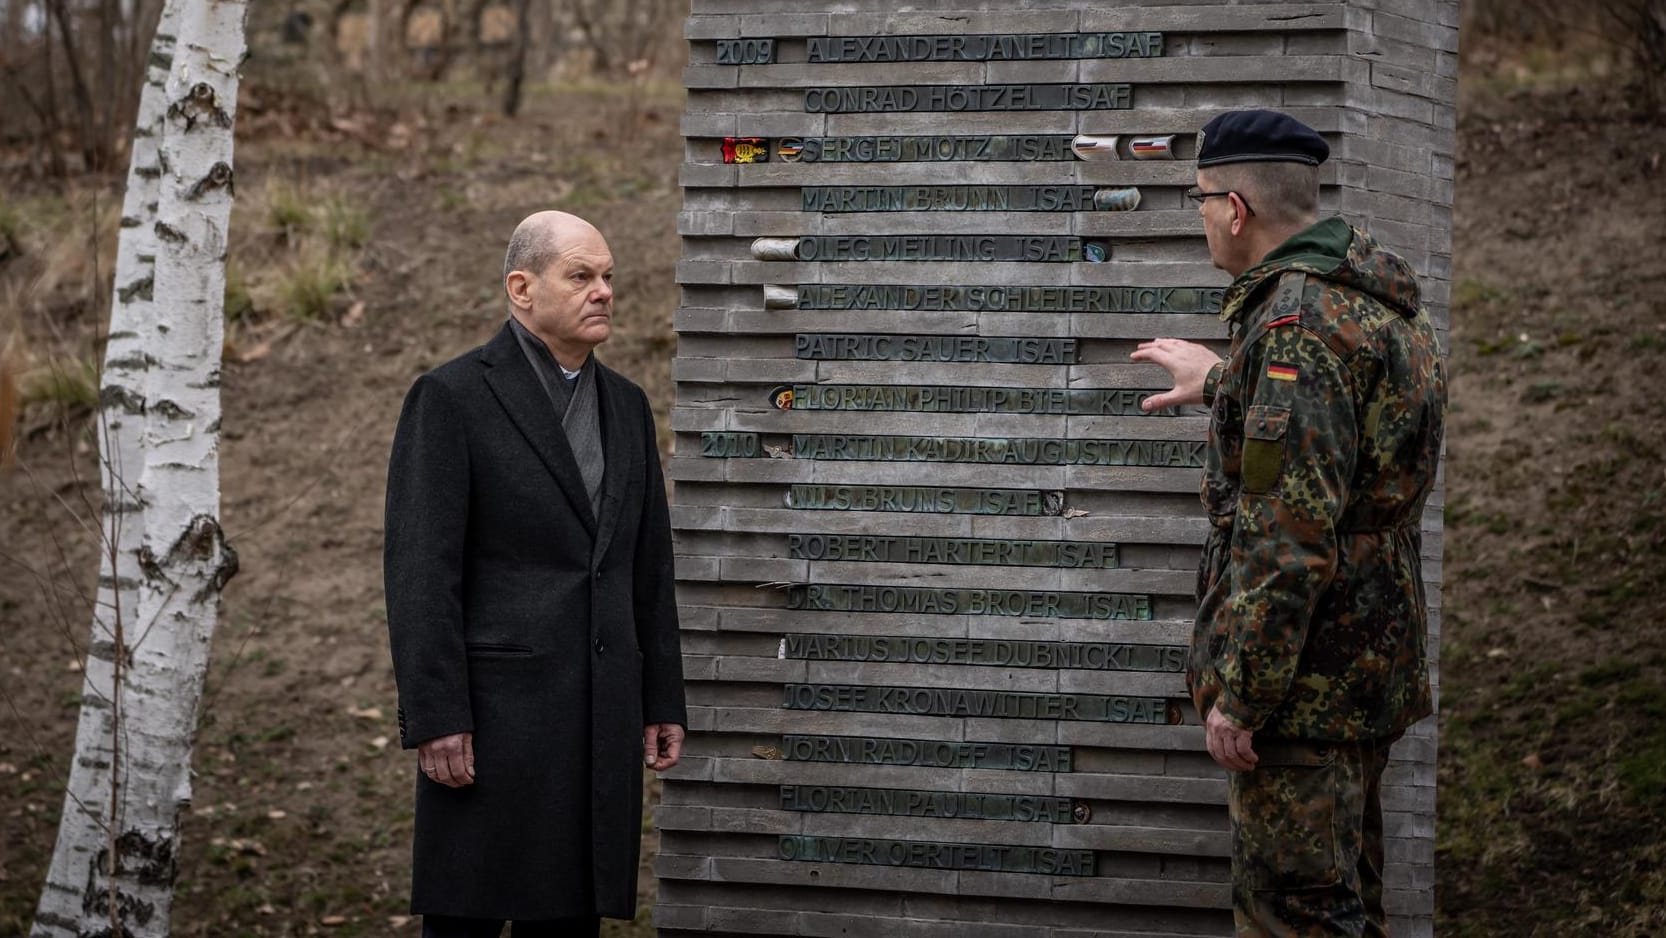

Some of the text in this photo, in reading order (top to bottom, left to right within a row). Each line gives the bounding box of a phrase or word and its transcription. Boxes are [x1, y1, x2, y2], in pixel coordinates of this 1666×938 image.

[717, 40, 772, 64] 2009
[807, 33, 1162, 61] ALEXANDER JANELT ISAF
[804, 84, 1131, 112] CONRAD HÖTZEL ISAF
[803, 137, 1072, 161] SERGEJ MOTZ ISAF
[801, 186, 1094, 211] MARTIN BRUNN ISAF
[800, 238, 1080, 260] OLEG MEILING ISAF
[797, 287, 1223, 311] ALEXANDER SCHLEIERNICK IS
[796, 335, 1077, 363] PATRIC SAUER ISAF
[794, 386, 1174, 415] FLORIAN PHILIP BIEL KFO
[702, 433, 757, 456] 2010
[793, 436, 1205, 465] MARTIN KADIR AUGUSTYNIAK
[791, 487, 1040, 514] NILS BRUNS ISAF
[789, 536, 1115, 567] ROBERT HARTERT ISAF
[788, 586, 1149, 619] DR. THOMAS BROER ISAF
[785, 635, 1187, 672] MARIUS JOSEF DUBNICKI IS
[784, 685, 1166, 723] JOSEF KRONAWITTER ISAF
[784, 735, 1071, 771] JÖRN RADLOFF ISAF
[779, 787, 1072, 823] FLORIAN PAULI ISAF
[777, 836, 1093, 875] OLIVER OERTELT ISAF
